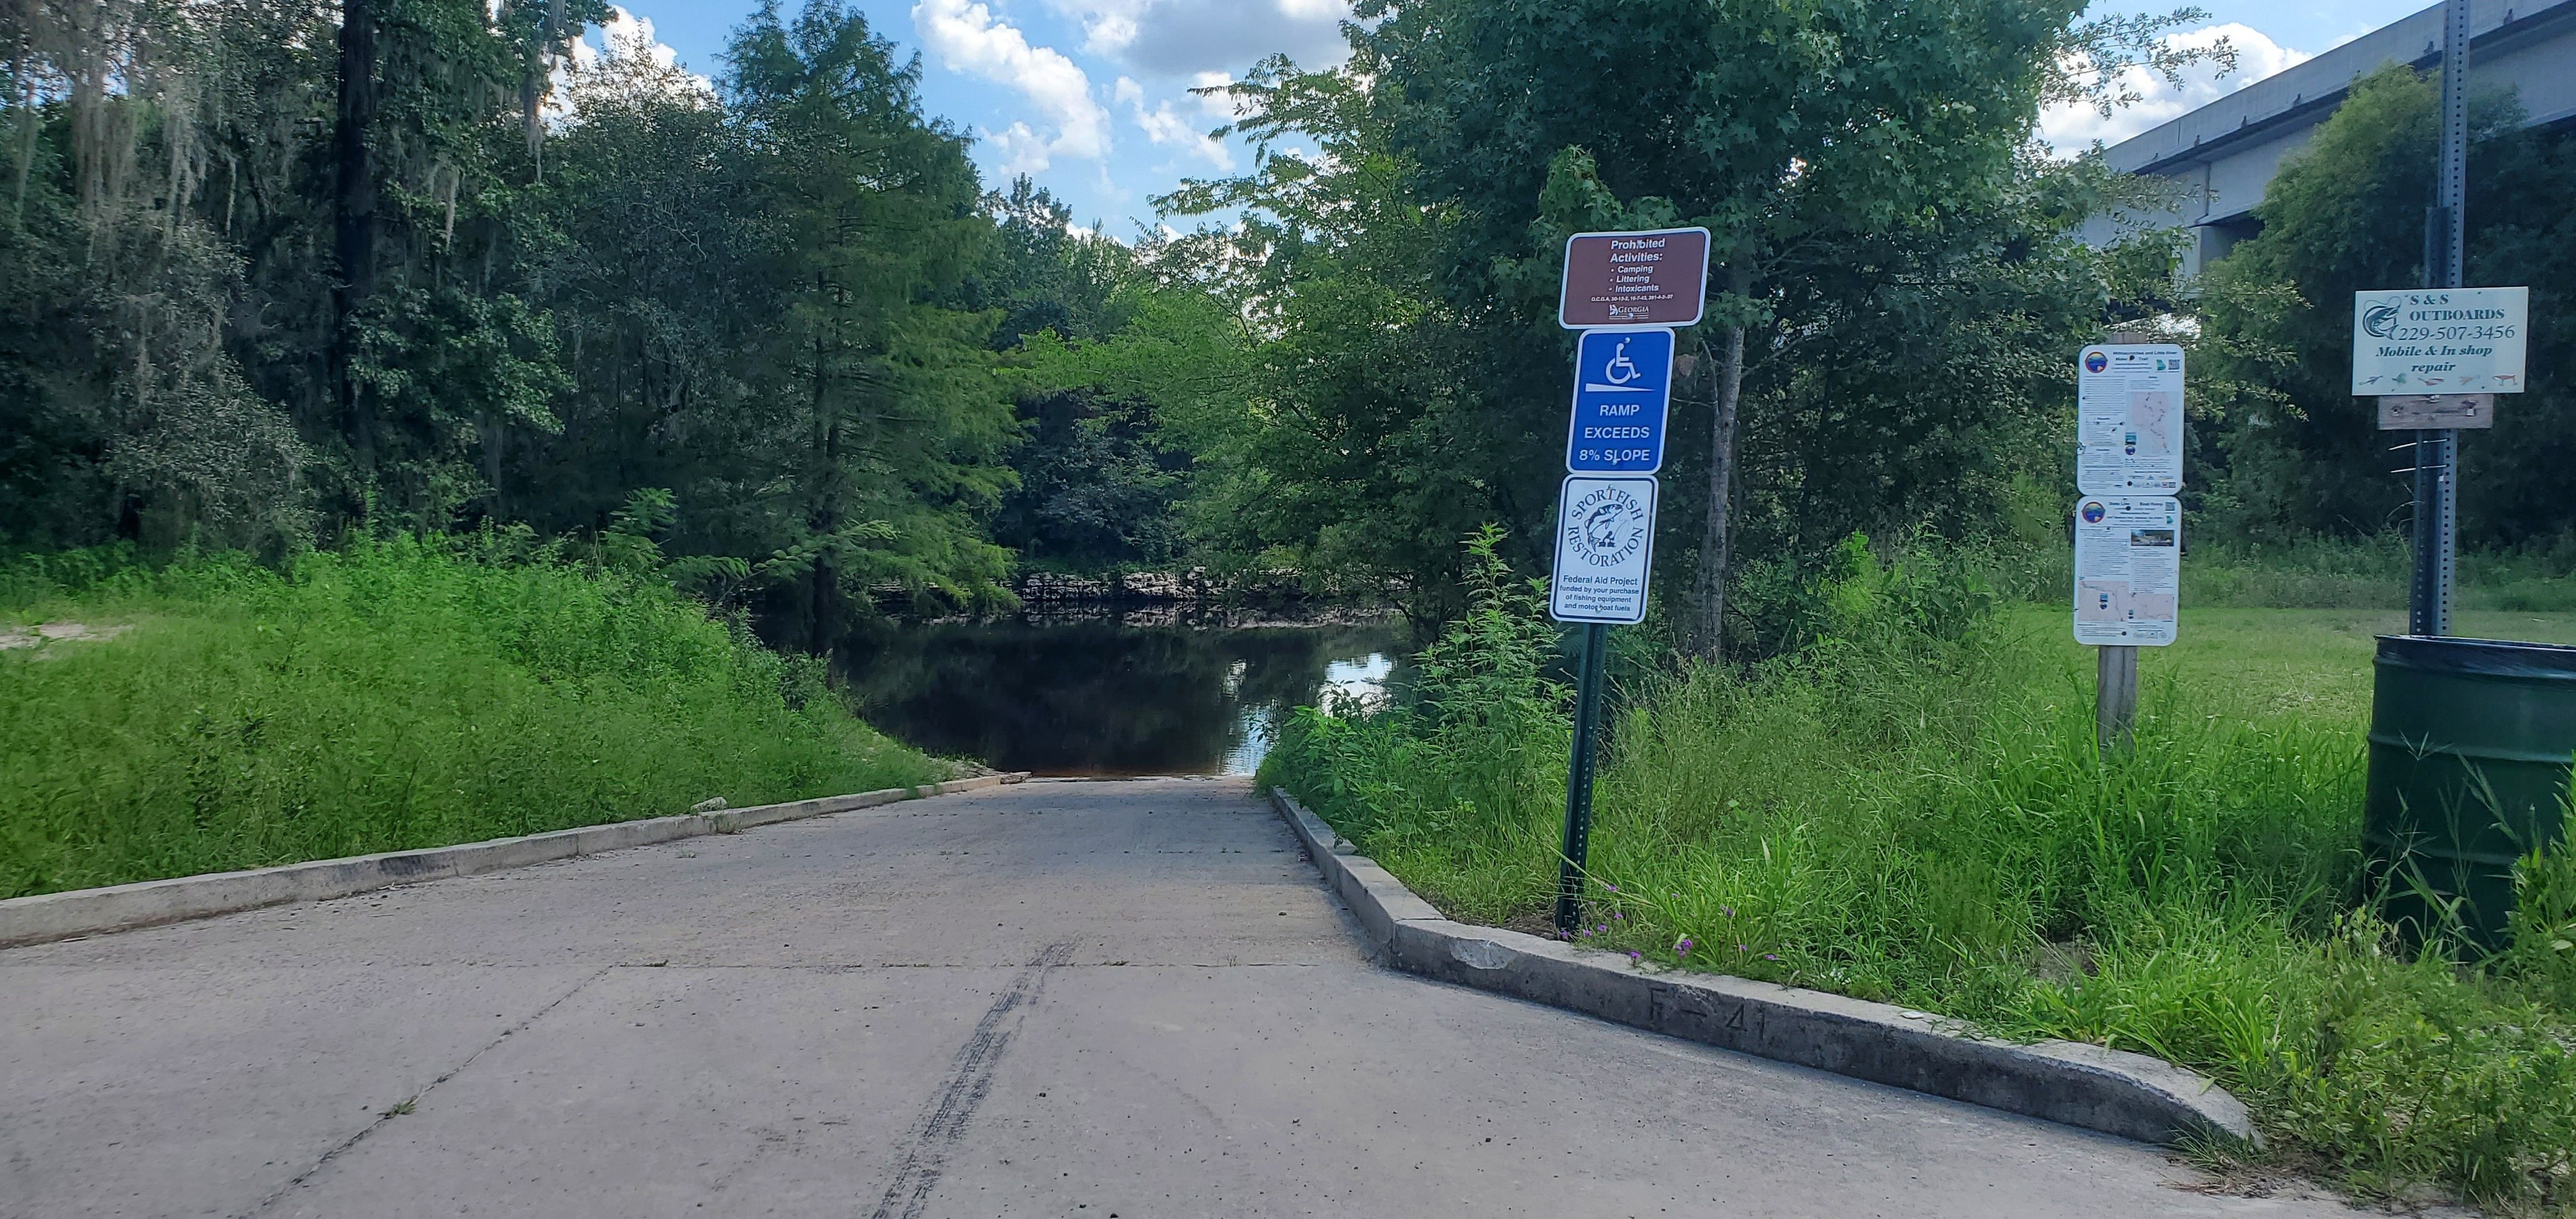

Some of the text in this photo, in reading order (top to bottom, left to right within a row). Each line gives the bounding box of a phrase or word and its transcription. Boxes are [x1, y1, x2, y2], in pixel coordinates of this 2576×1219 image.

[1610, 252, 1663, 263] Activities:
[1618, 265, 1653, 274] Camping
[1616, 275, 1650, 284] Littering
[1615, 284, 1659, 293] Intoxicants
[2411, 294, 2449, 305] S & S
[2409, 309, 2505, 321] OUTBOARDS
[2398, 325, 2515, 341] 229-507-3456
[2375, 344, 2493, 357] Mobile & In shop
[2411, 362, 2456, 374] repair
[1599, 404, 1640, 417] RAMP
[1584, 427, 1650, 439] EXCEEDS
[1579, 449, 1651, 461] 8% SLOPE
[1568, 526, 1644, 567] RESTORATION
[1563, 575, 1638, 587] Federal Aid Project
[1574, 594, 1596, 602] fishing
